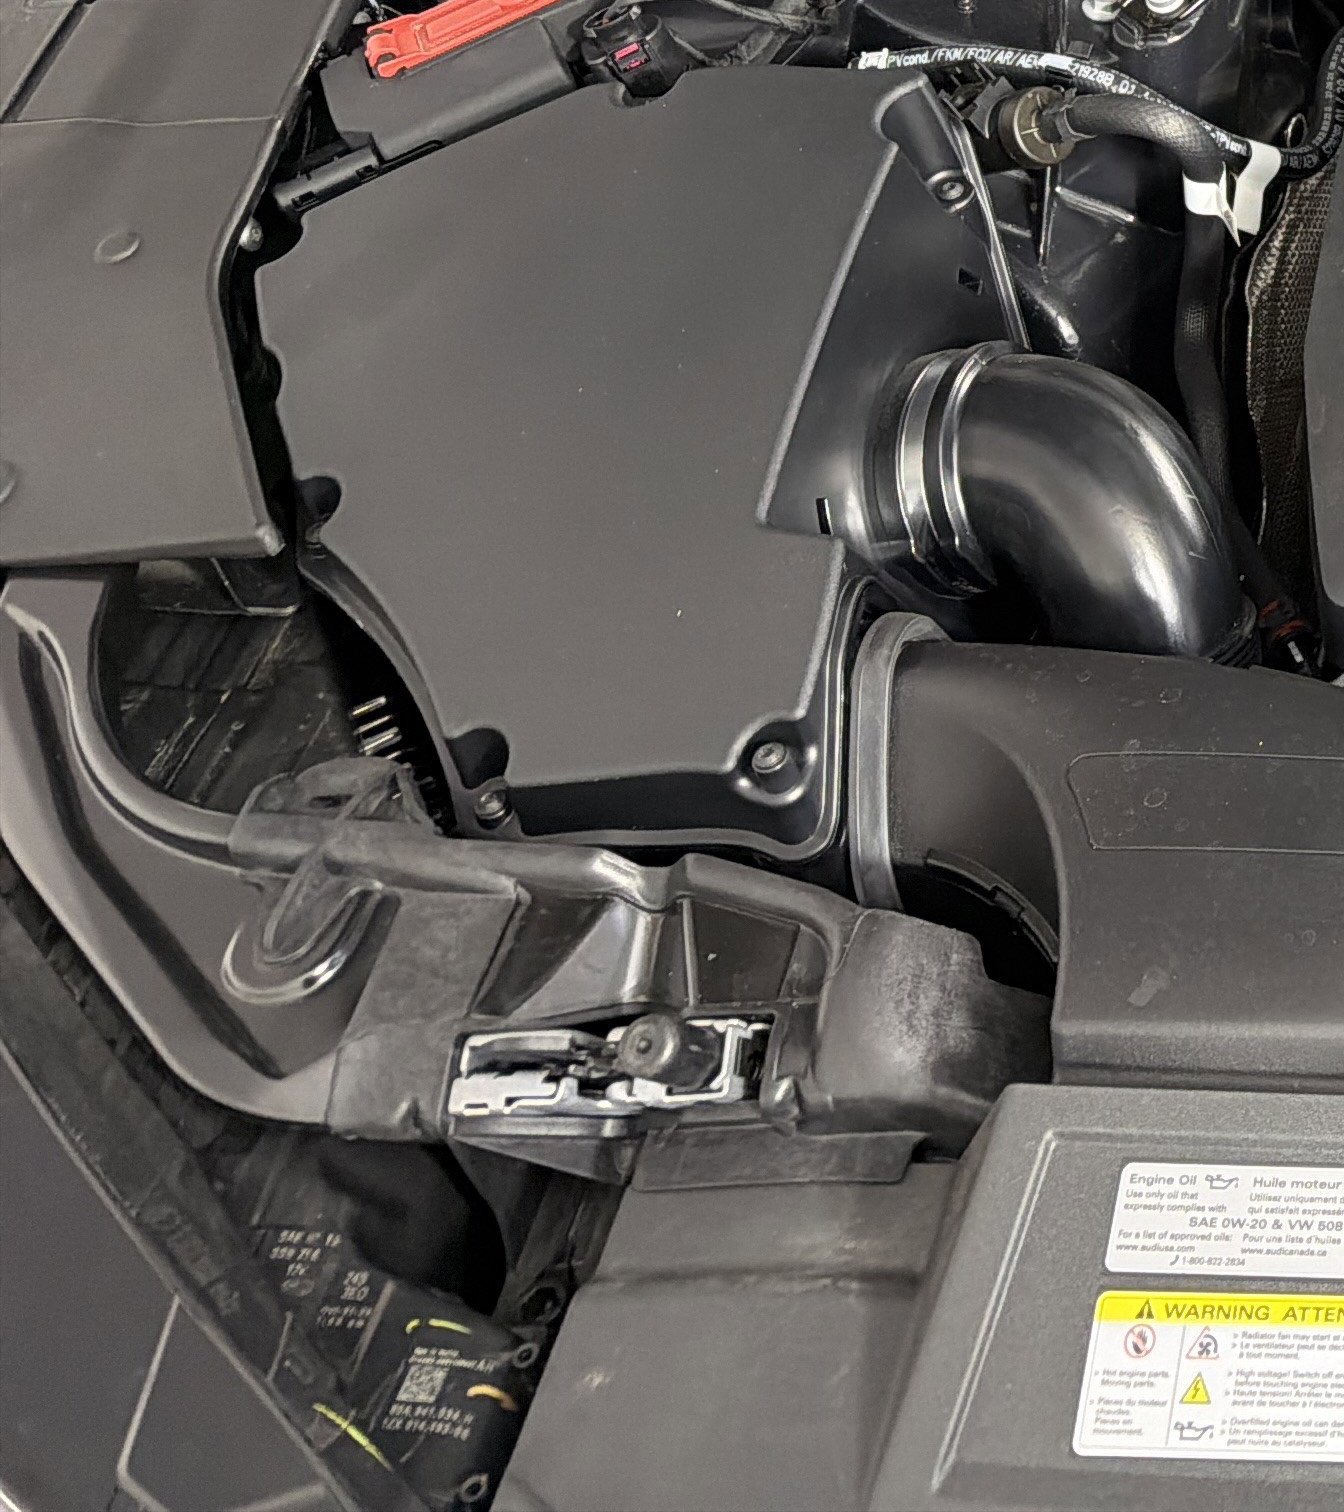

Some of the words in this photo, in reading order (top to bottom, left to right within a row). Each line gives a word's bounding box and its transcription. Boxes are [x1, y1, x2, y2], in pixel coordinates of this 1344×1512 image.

[1129, 1173, 1175, 1186] Engine
[1178, 1174, 1197, 1186] Oil
[1252, 1176, 1287, 1189] Huile
[1290, 1178, 1343, 1190] moteur
[1125, 1189, 1144, 1199] Use
[1145, 1190, 1165, 1200] only
[1166, 1190, 1179, 1200] oil
[1180, 1190, 1199, 1200] that
[1249, 1192, 1282, 1202] Utilisez
[1283, 1194, 1338, 1205] uniquement
[1123, 1203, 1165, 1212] expressly
[1166, 1203, 1206, 1213] complies
[1207, 1203, 1227, 1213] with
[1247, 1205, 1263, 1216] qui
[1264, 1206, 1300, 1216] satisfait
[1188, 1217, 1218, 1229] SAE
[1221, 1218, 1267, 1230] 0W-20
[1271, 1219, 1283, 1230] &
[1288, 1219, 1313, 1231] VW
[1317, 1220, 1343, 1232] 508
[1117, 1229, 1133, 1238] For
[1142, 1230, 1158, 1239] list
[1158, 1230, 1169, 1239] of
[1169, 1232, 1212, 1243] approved
[1213, 1233, 1233, 1242] oils:
[1241, 1233, 1264, 1244] Pour
[1265, 1235, 1283, 1244] une
[1285, 1234, 1304, 1244] liste
[1115, 1243, 1196, 1253] www.audiusa.com
[1239, 1247, 1328, 1257] www.audicanada.ca
[1164, 1302, 1270, 1321] WARNING
[1241, 1331, 1275, 1340] Radiator
[1277, 1332, 1291, 1340] fan
[1293, 1333, 1311, 1342] may
[1313, 1333, 1331, 1341] start
[1240, 1341, 1250, 1349] Le
[1252, 1342, 1294, 1350] ventilateur
[1236, 1369, 1256, 1380] High
[1292, 1370, 1320, 1379] Switch
[1322, 1371, 1333, 1379] off
[1234, 1379, 1261, 1388] before
[1262, 1380, 1298, 1390] touching
[1300, 1382, 1328, 1391] engine
[1271, 1420, 1300, 1429] engine
[1301, 1419, 1312, 1428] oil
[1228, 1428, 1241, 1436] Un
